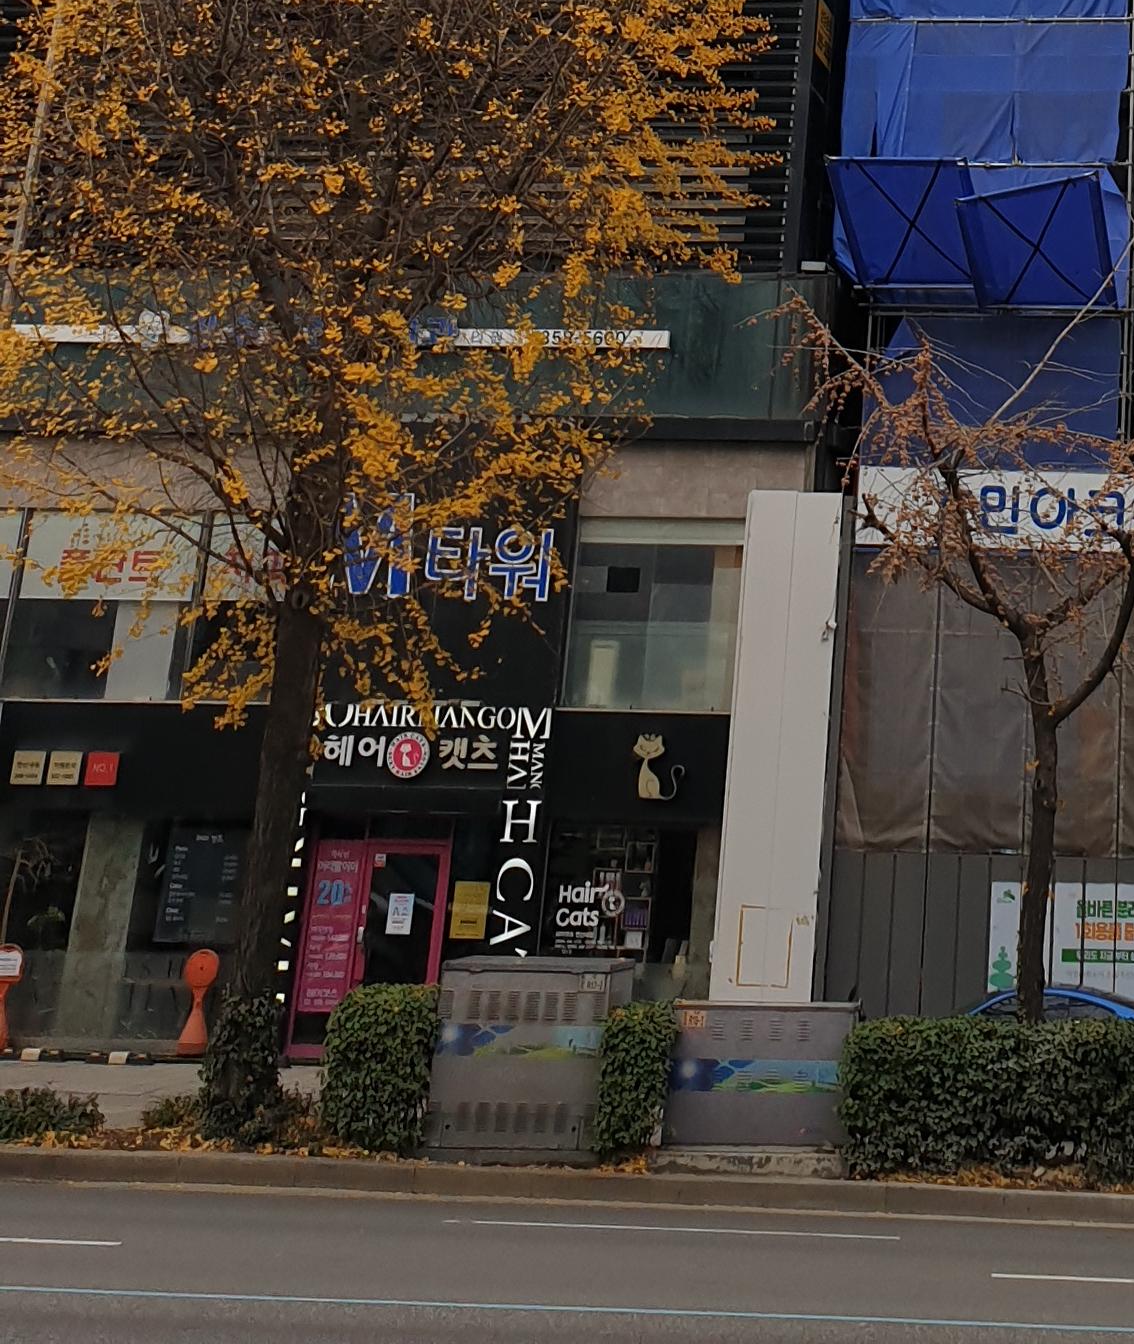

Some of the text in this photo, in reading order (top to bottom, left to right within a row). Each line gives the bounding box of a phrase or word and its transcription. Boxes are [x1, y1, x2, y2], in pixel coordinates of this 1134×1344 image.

[323, 734, 387, 767] 헤어
[438, 734, 499, 770] 캣츠
[558, 880, 609, 903] Hair
[556, 907, 600, 927] Cats
